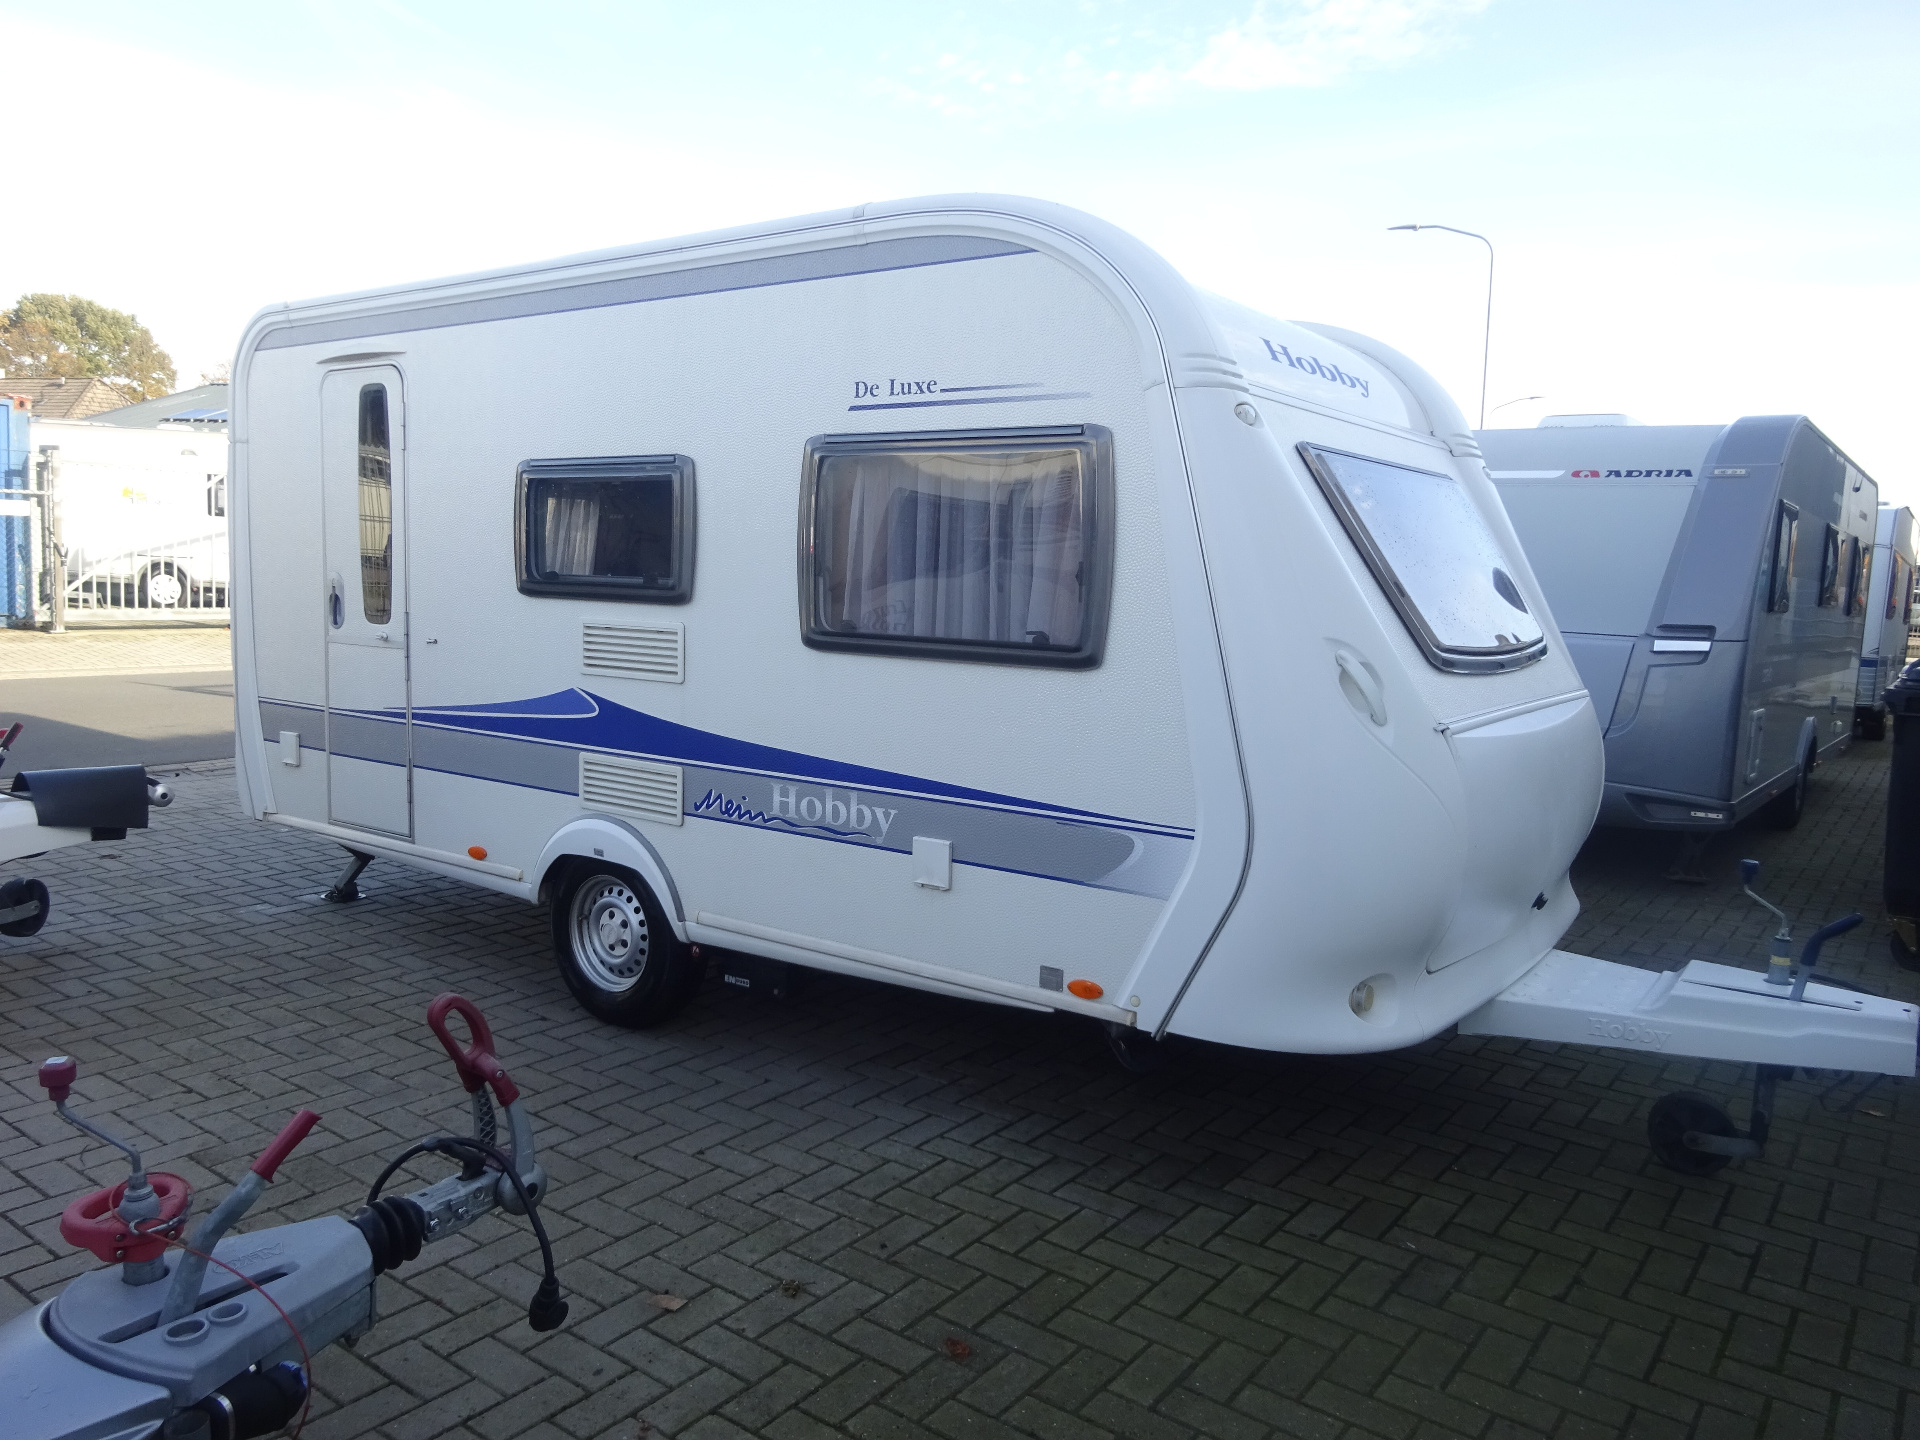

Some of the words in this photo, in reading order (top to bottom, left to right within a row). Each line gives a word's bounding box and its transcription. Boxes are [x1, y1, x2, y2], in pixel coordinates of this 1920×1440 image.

[1259, 336, 1370, 399] Hobby
[853, 381, 880, 399] De
[888, 378, 938, 397] Luxe
[1604, 469, 1694, 478] ADRIA
[694, 788, 771, 824] Mein
[769, 782, 899, 844] Hobby
[1586, 1016, 1673, 1051] Hobby
